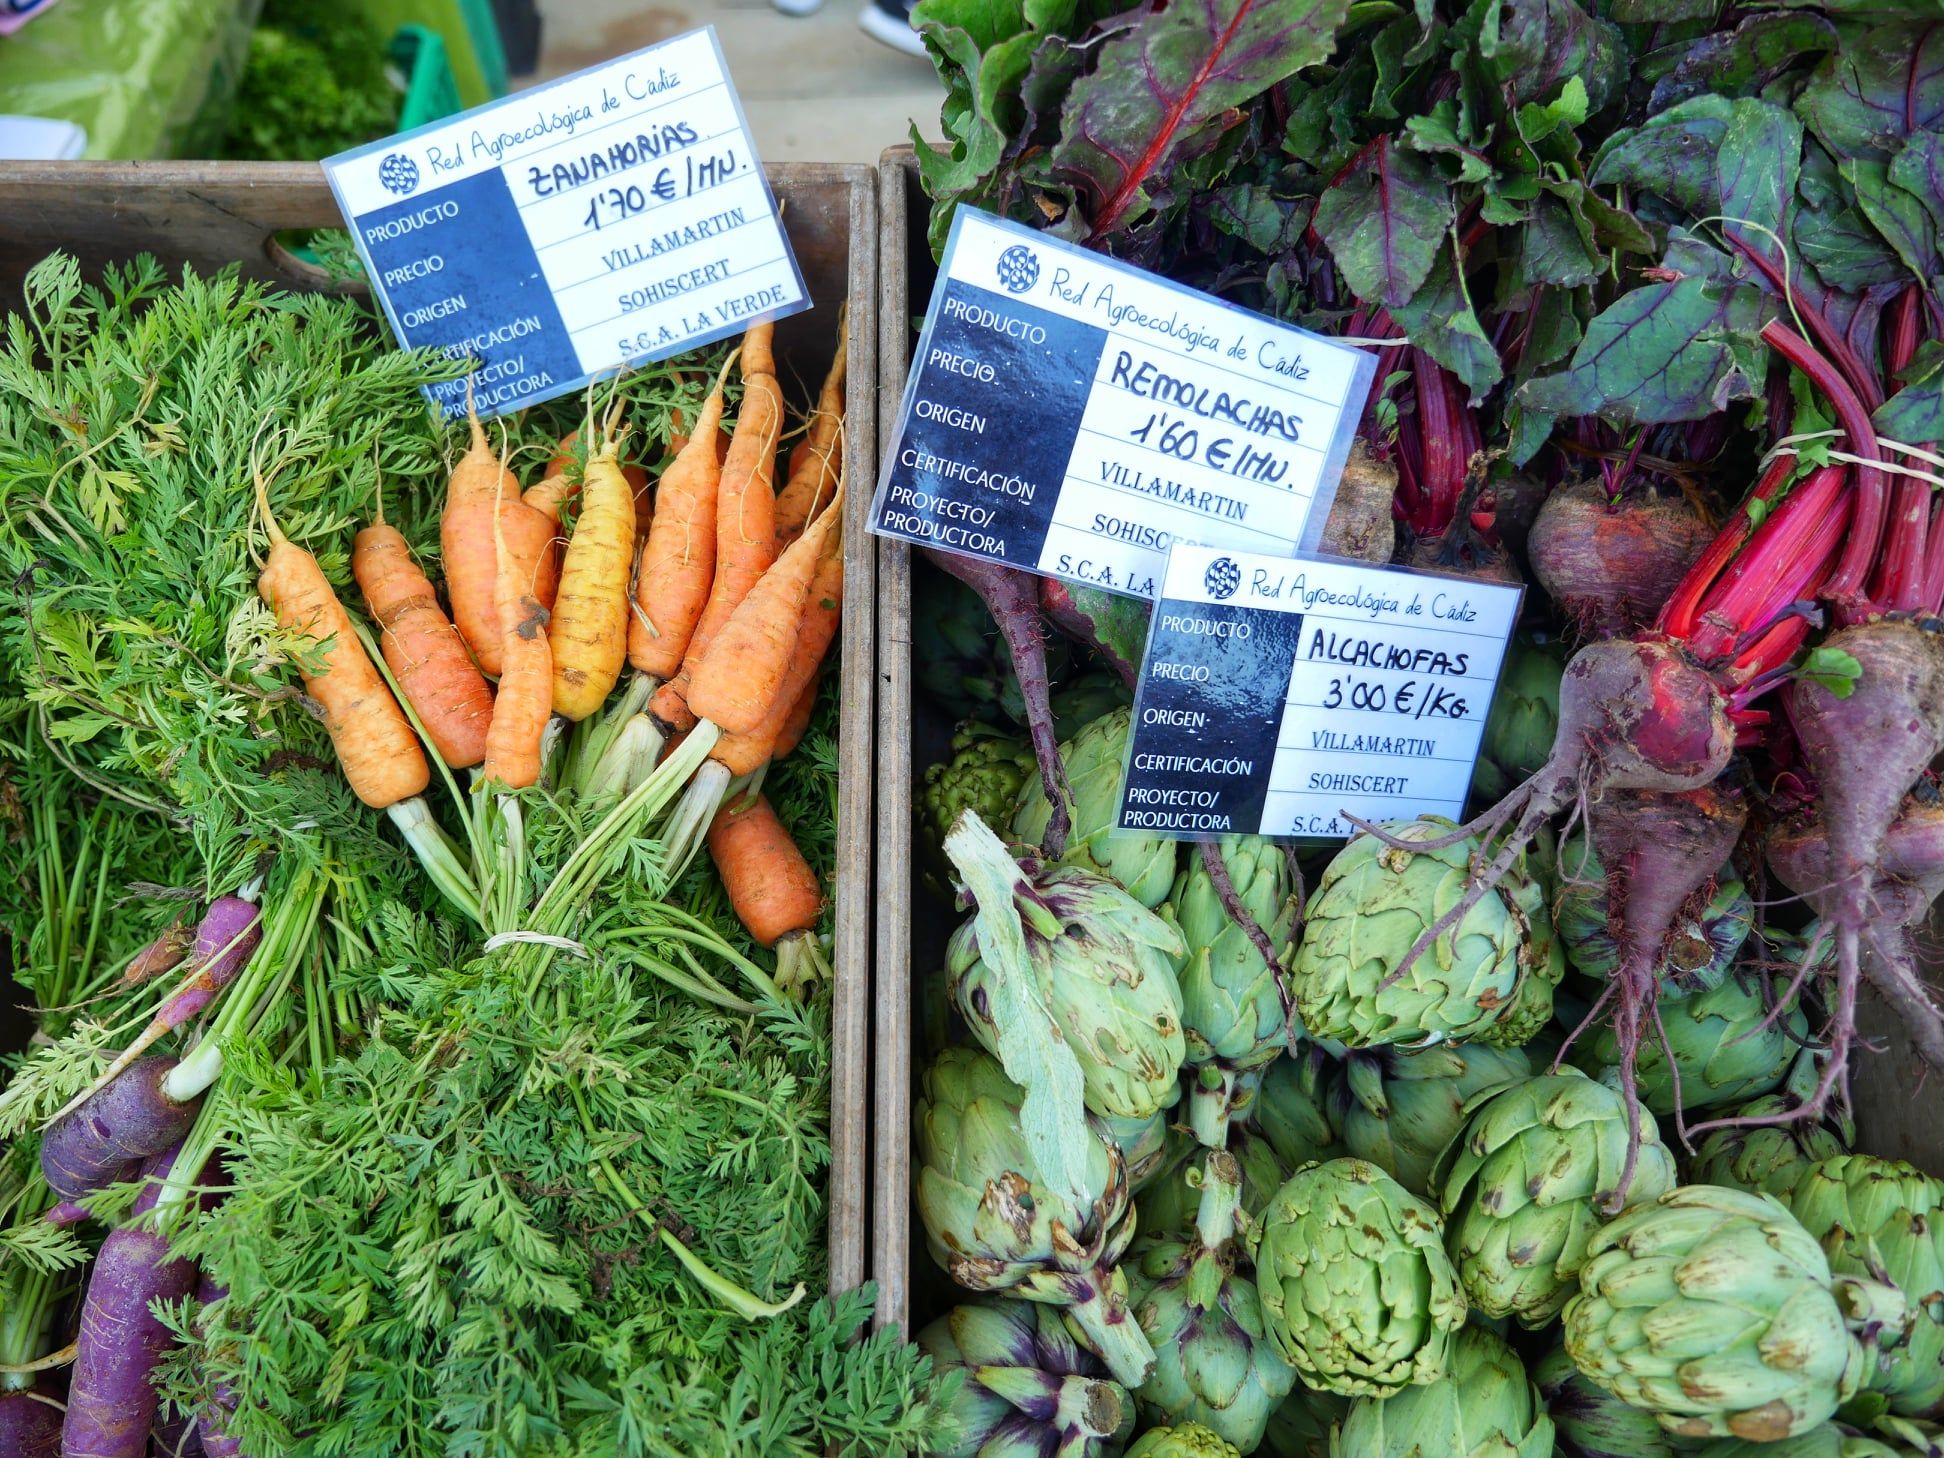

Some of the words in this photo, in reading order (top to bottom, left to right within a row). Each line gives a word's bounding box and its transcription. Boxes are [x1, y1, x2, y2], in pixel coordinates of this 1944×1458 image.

[427, 146, 465, 177] Red
[471, 104, 594, 161] Agroecológica
[601, 84, 621, 113] de
[625, 66, 682, 102] Cádiz
[366, 200, 459, 246] PRODUCTO
[601, 206, 746, 274] VILLAMARTIN
[384, 254, 444, 288] PRECIO
[618, 258, 733, 313] SOHISCERT
[402, 294, 468, 329] ORIGEN
[683, 309, 713, 336] LA
[715, 283, 787, 323] VERDE
[943, 298, 1047, 345] PRODUCTO
[1049, 268, 1089, 306] Red
[1094, 284, 1219, 353] Agroecológica
[1227, 335, 1249, 361] de
[1258, 340, 1310, 381] Cádiz
[929, 349, 996, 383] PRECIO
[915, 400, 987, 435] ORIGEN
[901, 449, 1037, 501] CERTIFICACIÓN
[1100, 460, 1250, 522] VILLAMARTIN
[890, 485, 996, 530] PROYECTO/
[883, 511, 1007, 557] PRODUCTORA
[1056, 554, 1119, 587] S.C.A.
[1126, 572, 1156, 598] LA
[1250, 568, 1281, 599] Red
[1289, 573, 1399, 618] Agroecológica
[1405, 595, 1423, 617] de
[1431, 592, 1478, 623] Cádiz
[1161, 615, 1251, 640] PRODUCTO
[1151, 662, 1210, 683] PRECIO
[1308, 627, 1470, 676] ALCACHOFAS
[1143, 707, 1206, 728] ORIGEN
[1134, 753, 1253, 777] CERTIFICACIÓN
[1311, 729, 1437, 757] VILLAMARTIN
[1127, 787, 1220, 809] PROYECTO/
[1308, 772, 1409, 795] SOHISCERT
[1124, 810, 1232, 831] PRODUCTORA
[1292, 816, 1343, 835] S.C.A.
